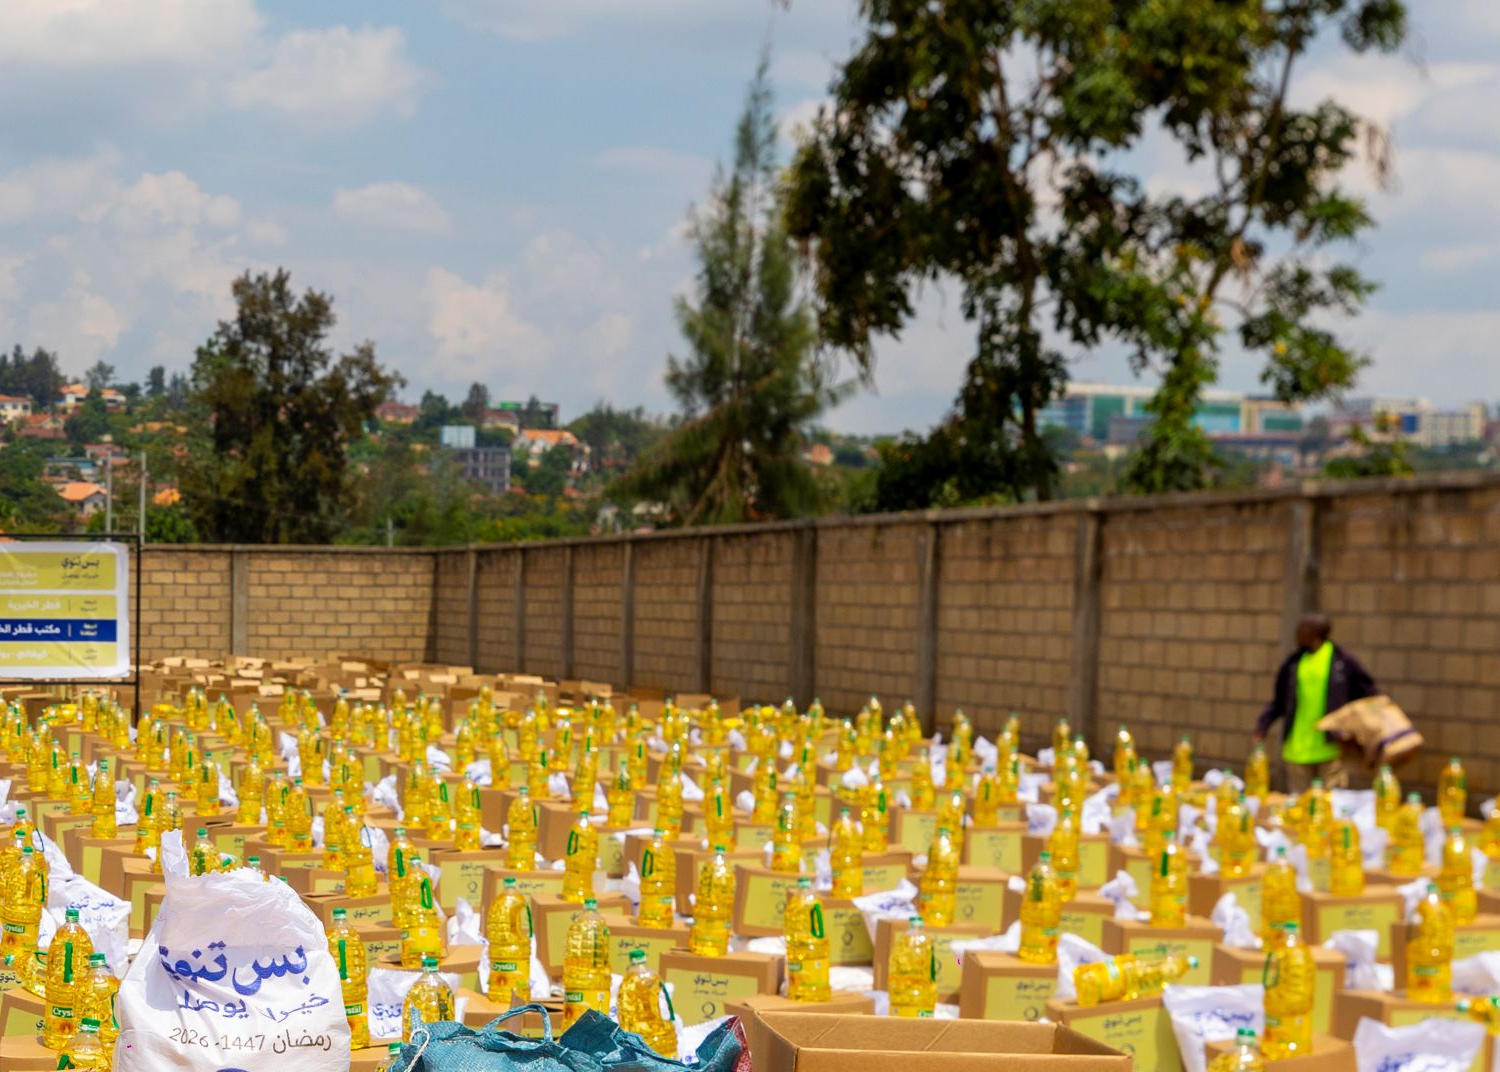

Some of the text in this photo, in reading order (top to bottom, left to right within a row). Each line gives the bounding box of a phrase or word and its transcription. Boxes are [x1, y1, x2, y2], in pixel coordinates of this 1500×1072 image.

[12, 623, 33, 636] قطر
[232, 945, 310, 996] بس
[169, 1027, 331, 1054] رمضان 2026
